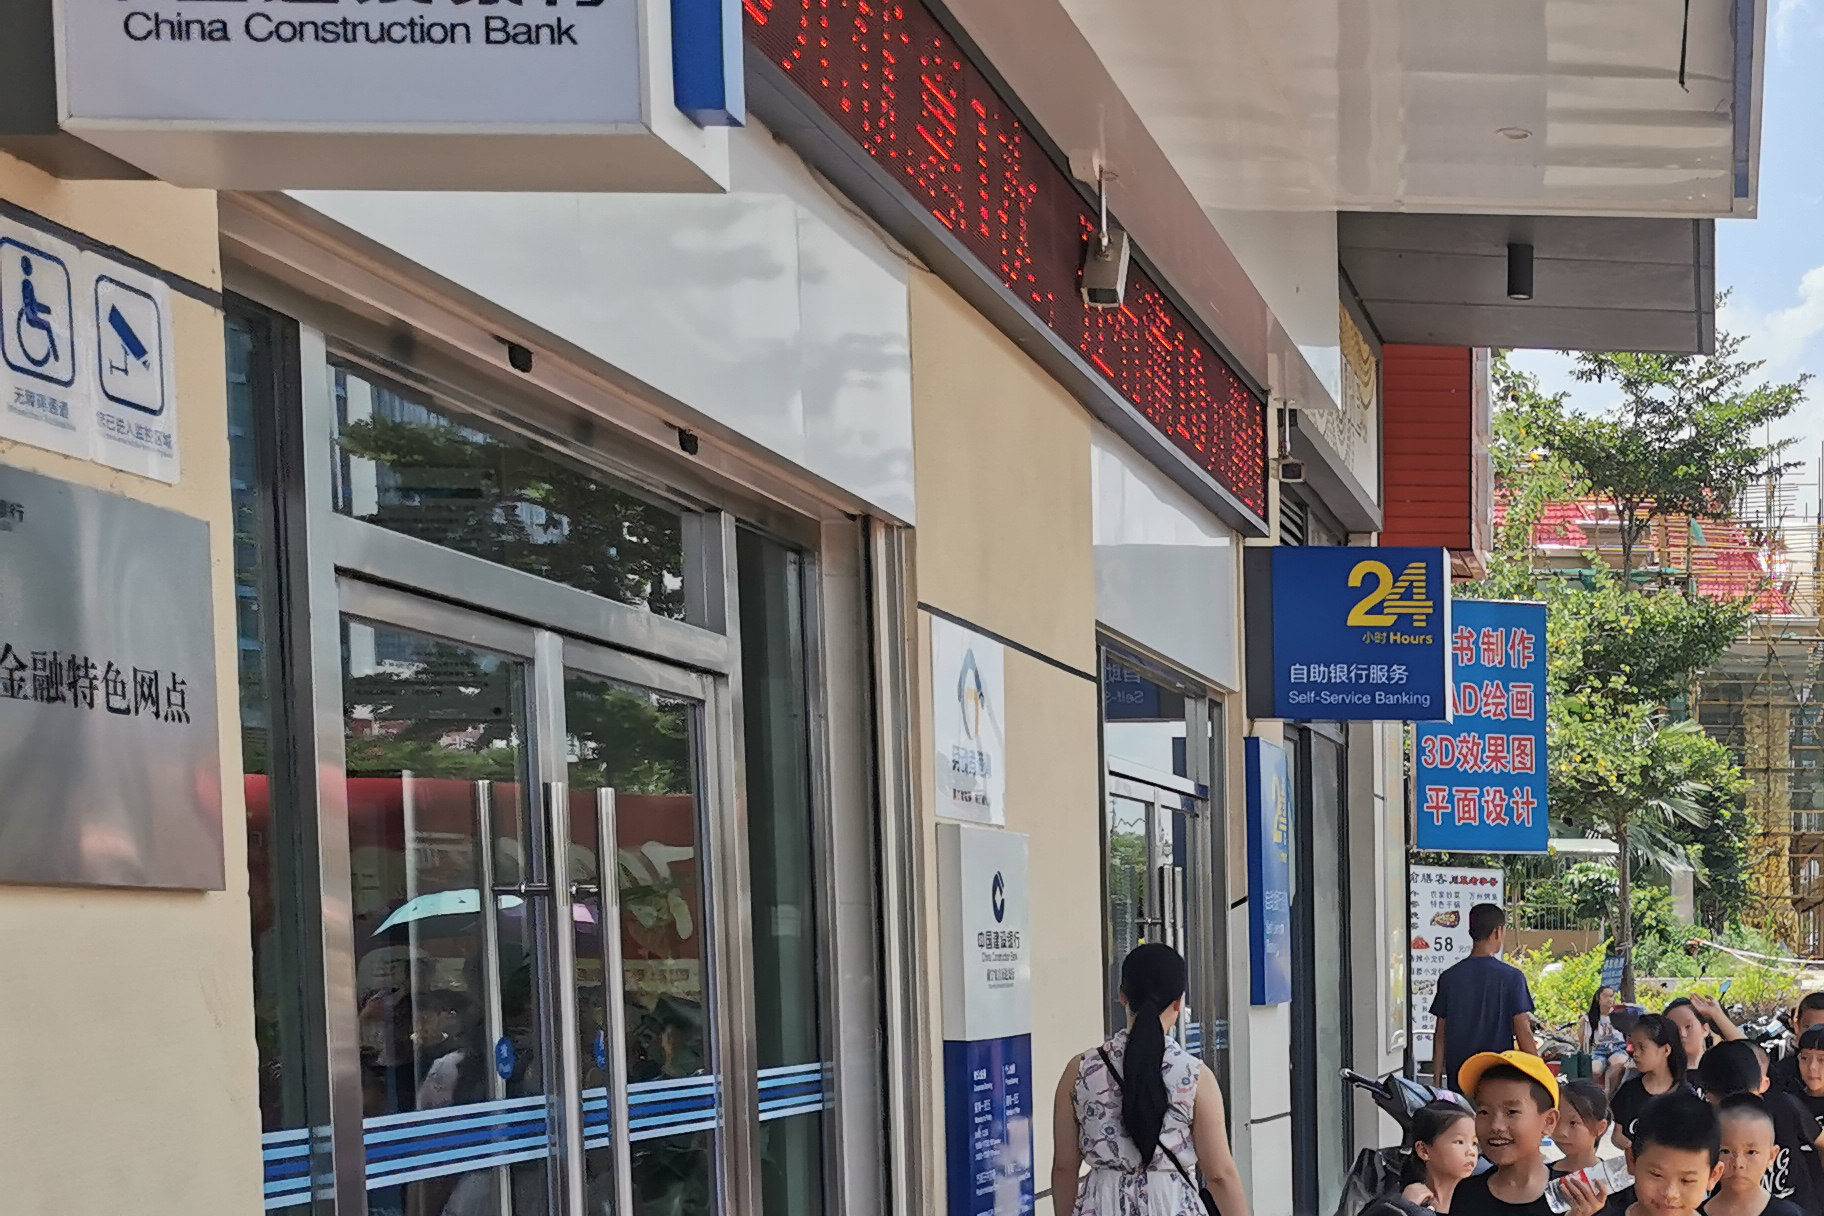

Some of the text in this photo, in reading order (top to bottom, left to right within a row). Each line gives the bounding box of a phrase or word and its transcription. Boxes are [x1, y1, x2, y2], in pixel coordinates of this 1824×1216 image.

[123, 11, 578, 46] China Construction Bank
[1346, 560, 1434, 627] 24
[1362, 631, 1434, 645] 小时 Hours
[0, 643, 191, 724] 金融特色网点
[1289, 663, 1409, 684] 自助银行服务
[1289, 690, 1431, 708] Self-Service Banking
[1421, 732, 1536, 774] 3D效果图
[1424, 785, 1537, 827] 平面设计
[1433, 936, 1453, 951] 58
